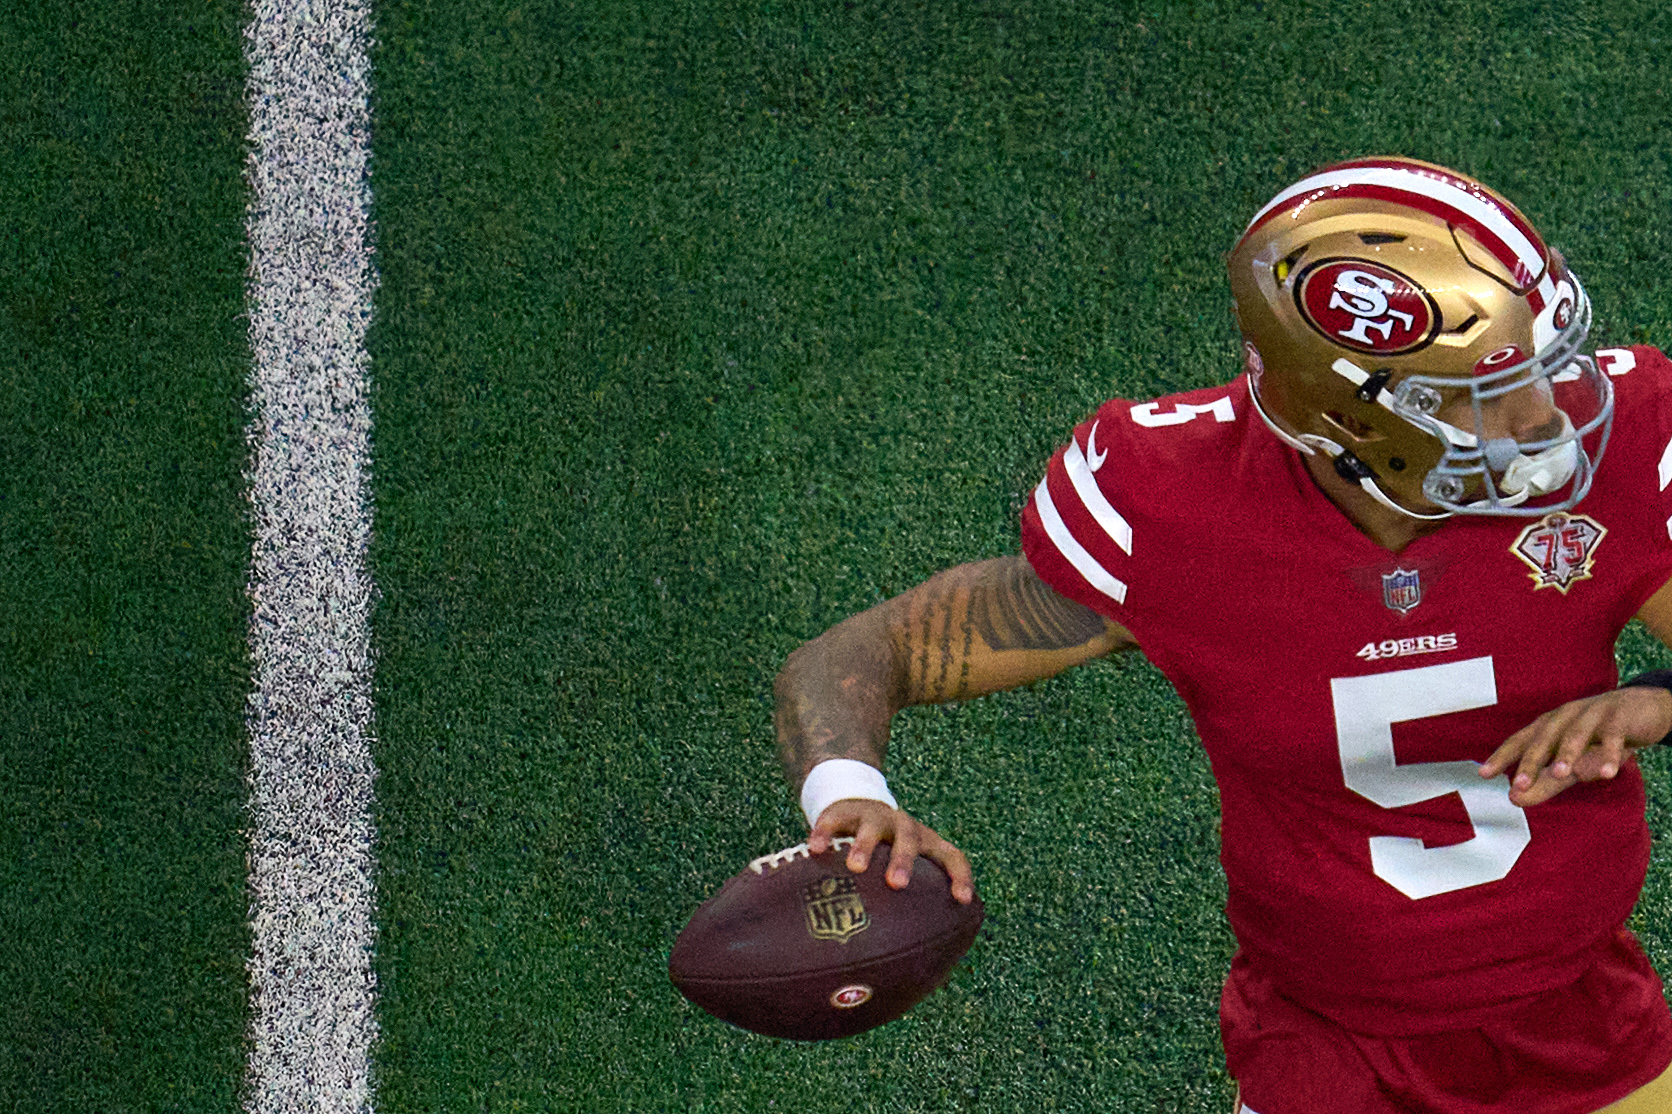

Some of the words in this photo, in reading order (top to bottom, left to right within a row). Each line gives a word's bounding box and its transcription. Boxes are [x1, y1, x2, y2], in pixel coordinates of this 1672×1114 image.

[1328, 270, 1415, 345] SF
[1536, 528, 1586, 569] 75
[1356, 632, 1459, 662] 49ERS
[1330, 655, 1532, 900] 5
[811, 898, 864, 931] NFL
